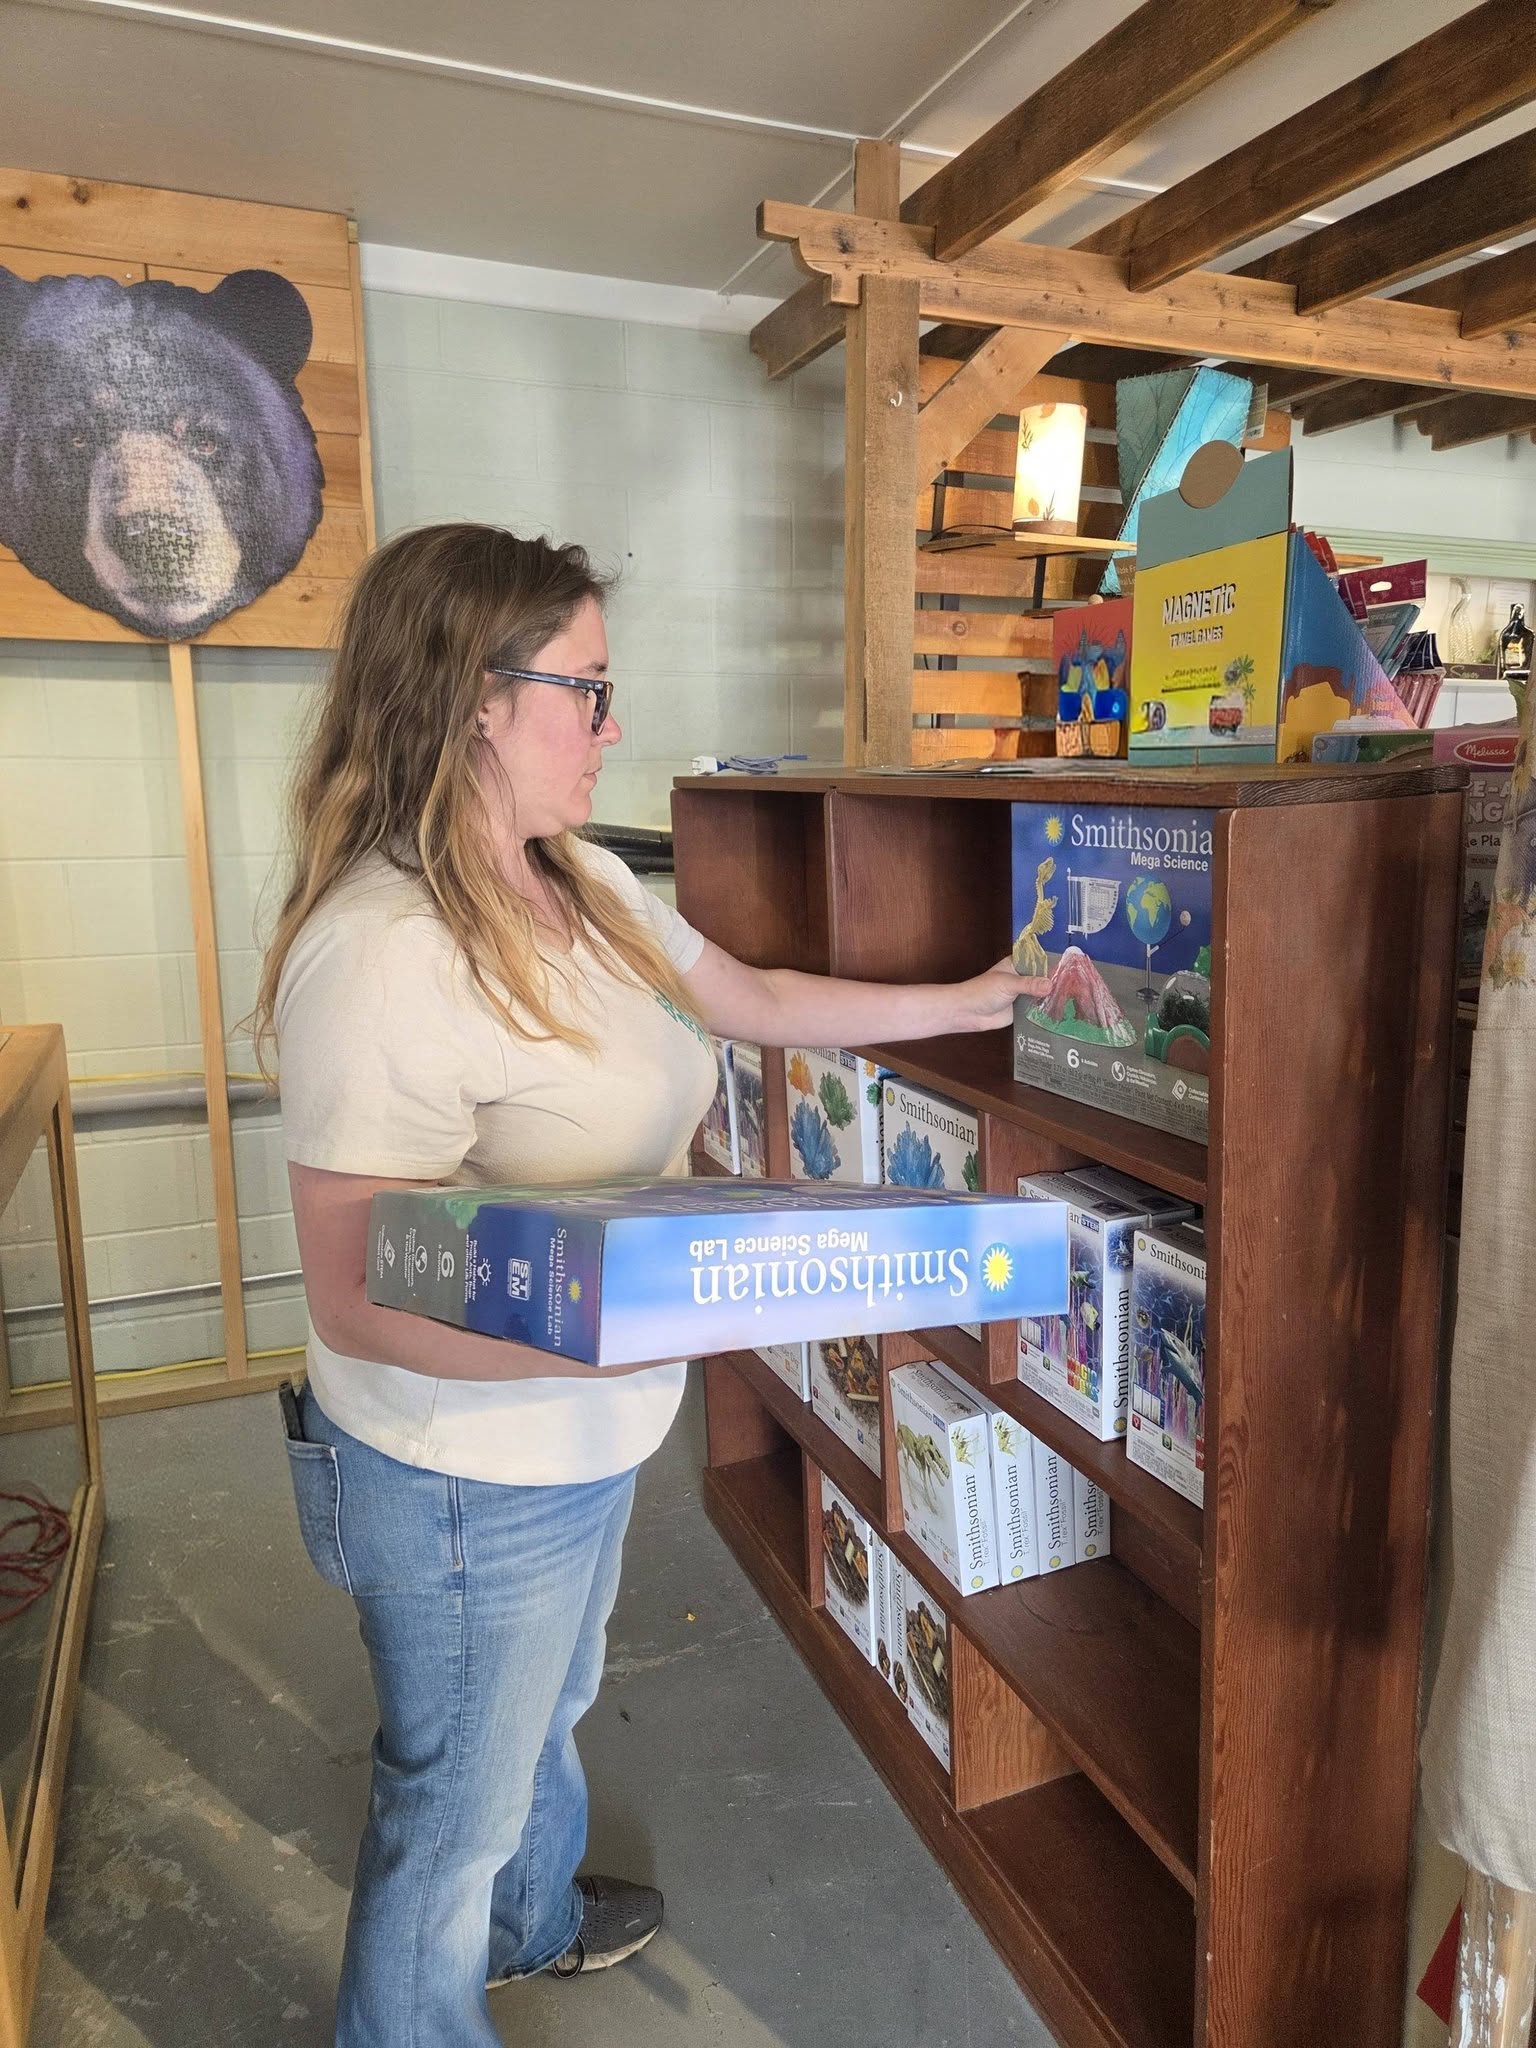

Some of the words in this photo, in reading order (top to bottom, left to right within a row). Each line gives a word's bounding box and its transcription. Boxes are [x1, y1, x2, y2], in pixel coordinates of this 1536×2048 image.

[1162, 582, 1237, 627] MAGNETIC
[1170, 629, 1197, 649] TRAVEL
[1197, 625, 1224, 643] GAMES
[1464, 742, 1510, 759] Melissa
[1071, 813, 1213, 856] Smithsonia
[1481, 834, 1501, 847] Pla
[1130, 851, 1161, 870] Mega
[1163, 854, 1209, 872] Science
[1067, 1048, 1080, 1069] 6
[899, 1091, 977, 1146] Smithsonian
[688, 1238, 728, 1261] Lab
[733, 1233, 811, 1257] Science
[816, 1227, 869, 1252] Mega
[441, 1251, 455, 1278] 6
[690, 1247, 969, 1315] Smithsonian
[1149, 1243, 1206, 1281] Smithsoni
[547, 1270, 555, 1313] Science
[554, 1227, 568, 1347] Smithsonian
[1113, 1287, 1130, 1410] Smithsonian
[964, 1473, 983, 1570] Smithsonian
[1004, 1463, 1023, 1560] Smithsonian
[1045, 1454, 1061, 1550] Smithsonian
[1083, 1479, 1098, 1539] Smithso
[877, 1552, 886, 1634] Smithsonian
